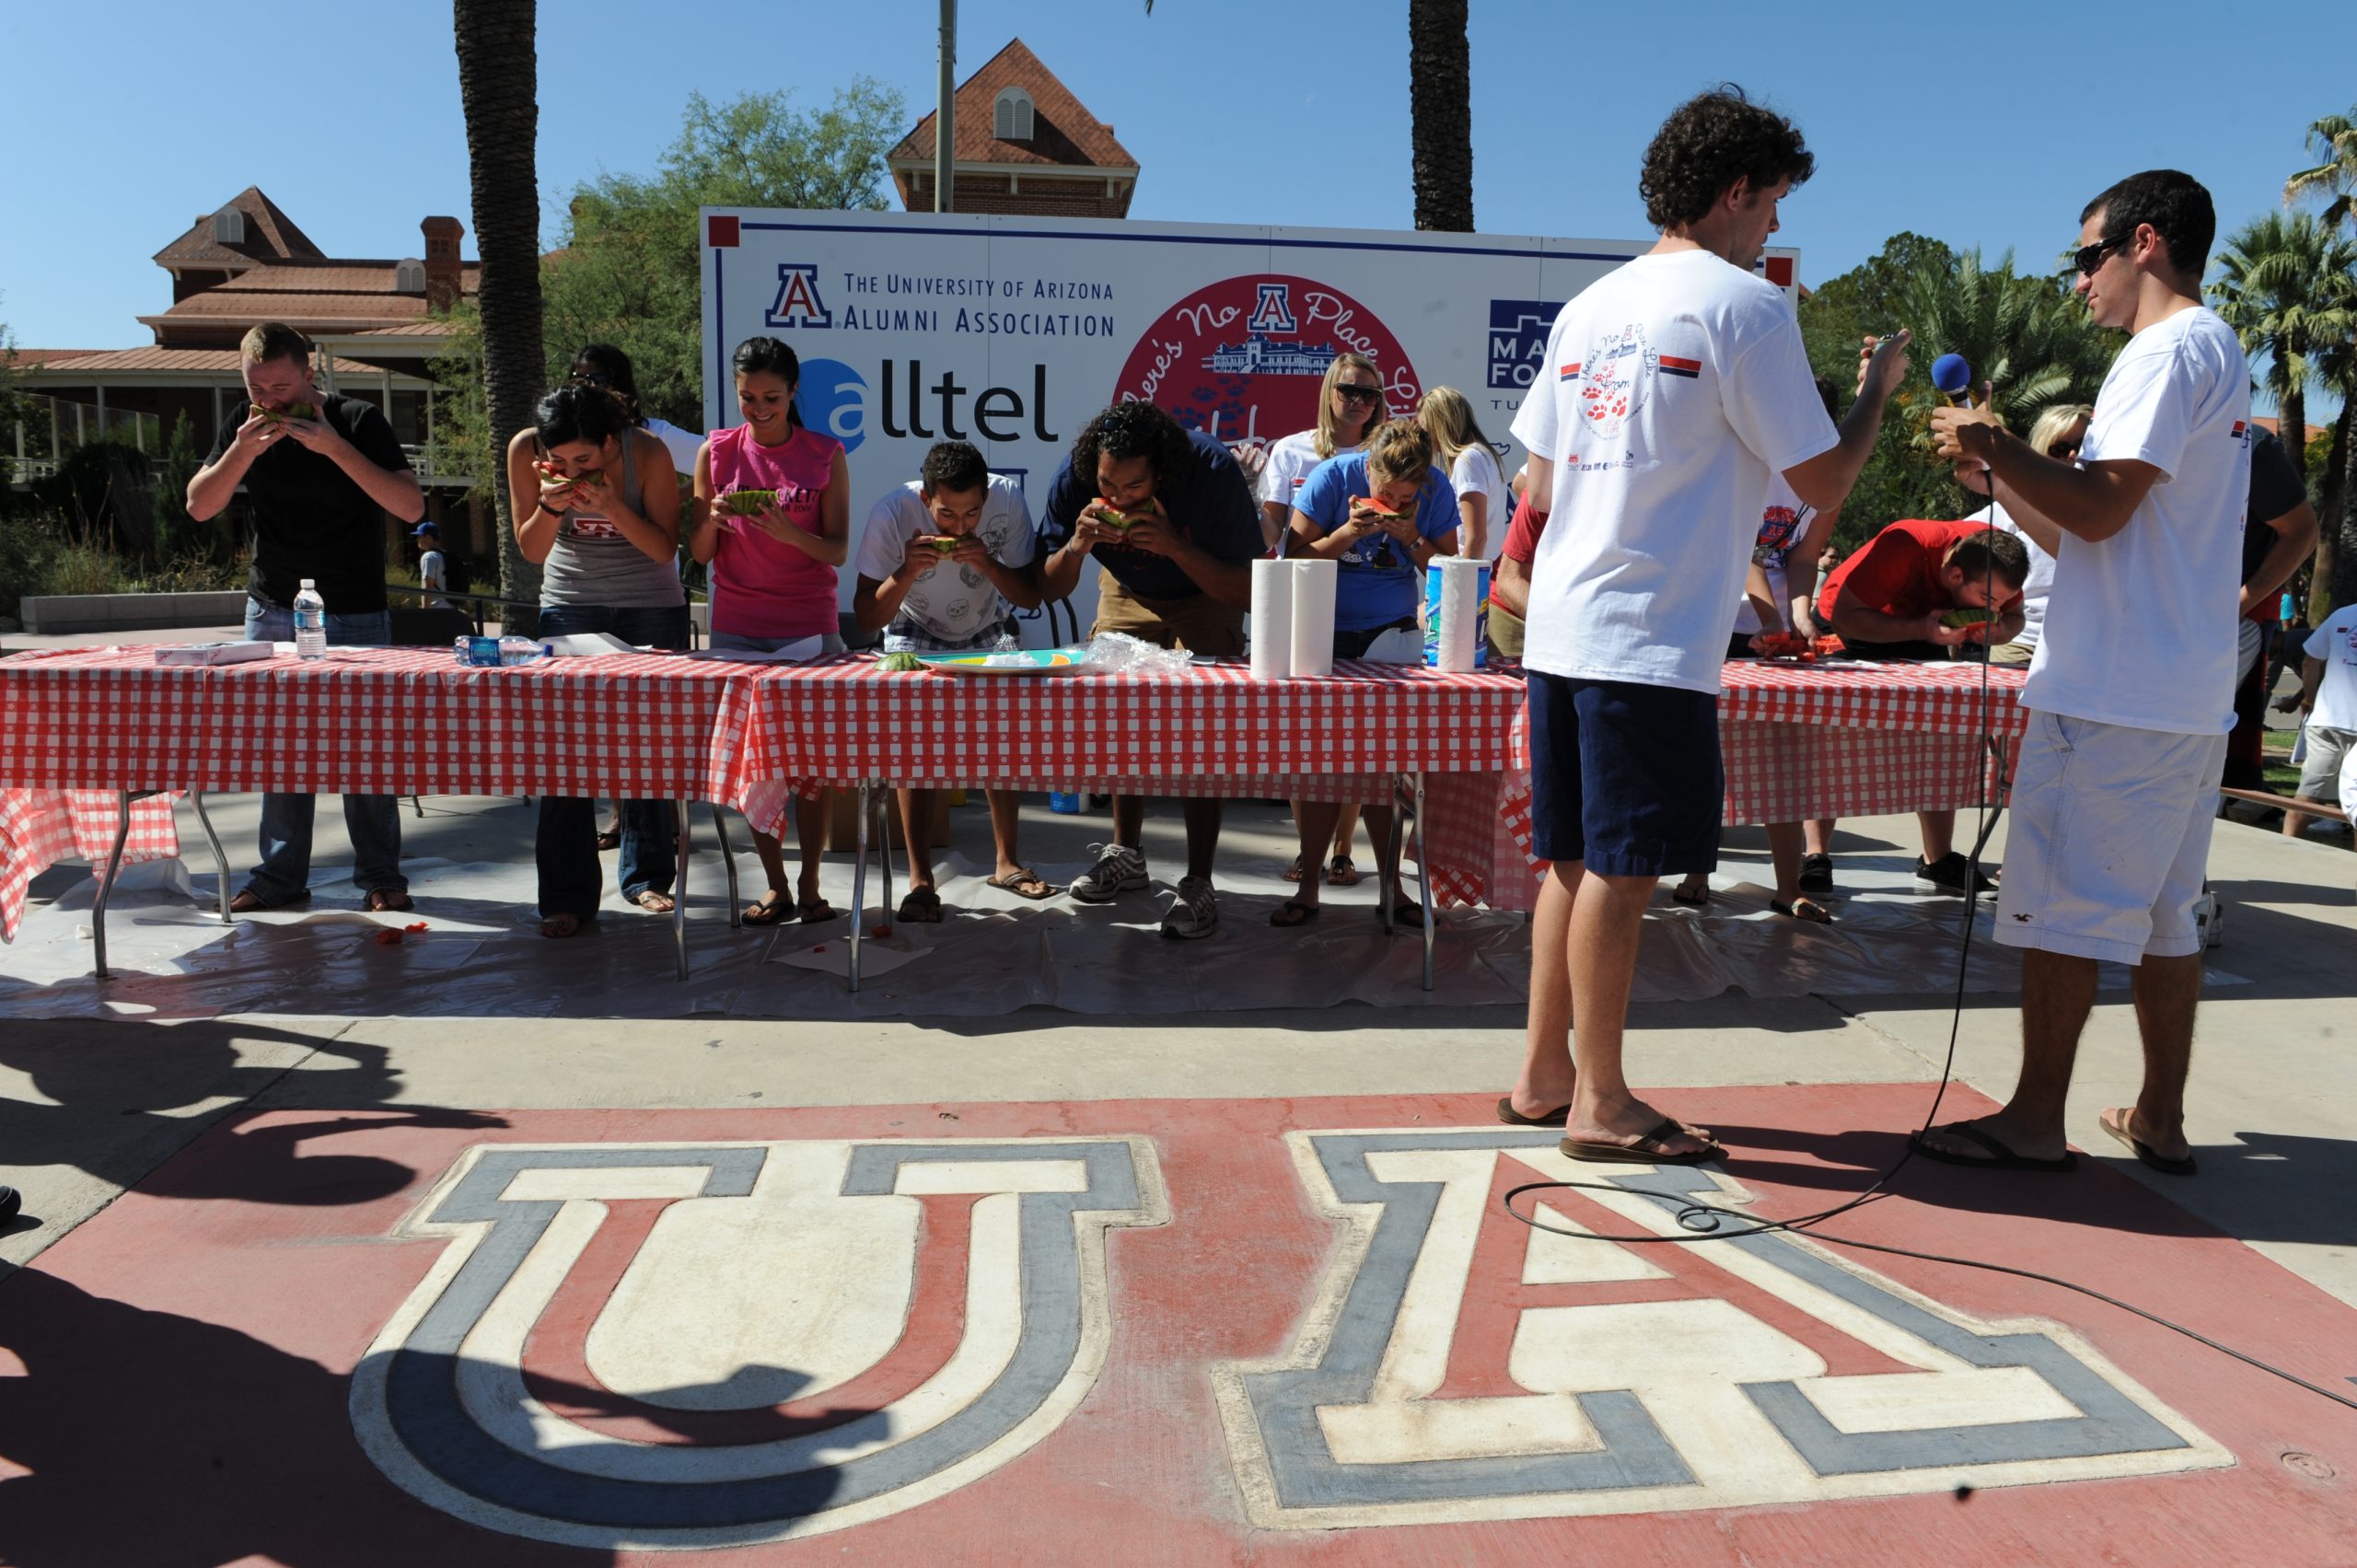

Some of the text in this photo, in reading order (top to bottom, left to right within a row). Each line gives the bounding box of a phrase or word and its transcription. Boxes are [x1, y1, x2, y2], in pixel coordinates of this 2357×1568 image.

[765, 263, 832, 329] A
[843, 273, 1113, 300] THE UNIVERSITY OF ARIZONA
[842, 305, 1115, 337] ALUMNI ASSOCIATION
[1176, 303, 1241, 337] No
[1304, 292, 1379, 364] Place
[1492, 336, 1548, 360] MA
[828, 359, 1060, 443] alltel
[1490, 400, 1519, 411] TU
